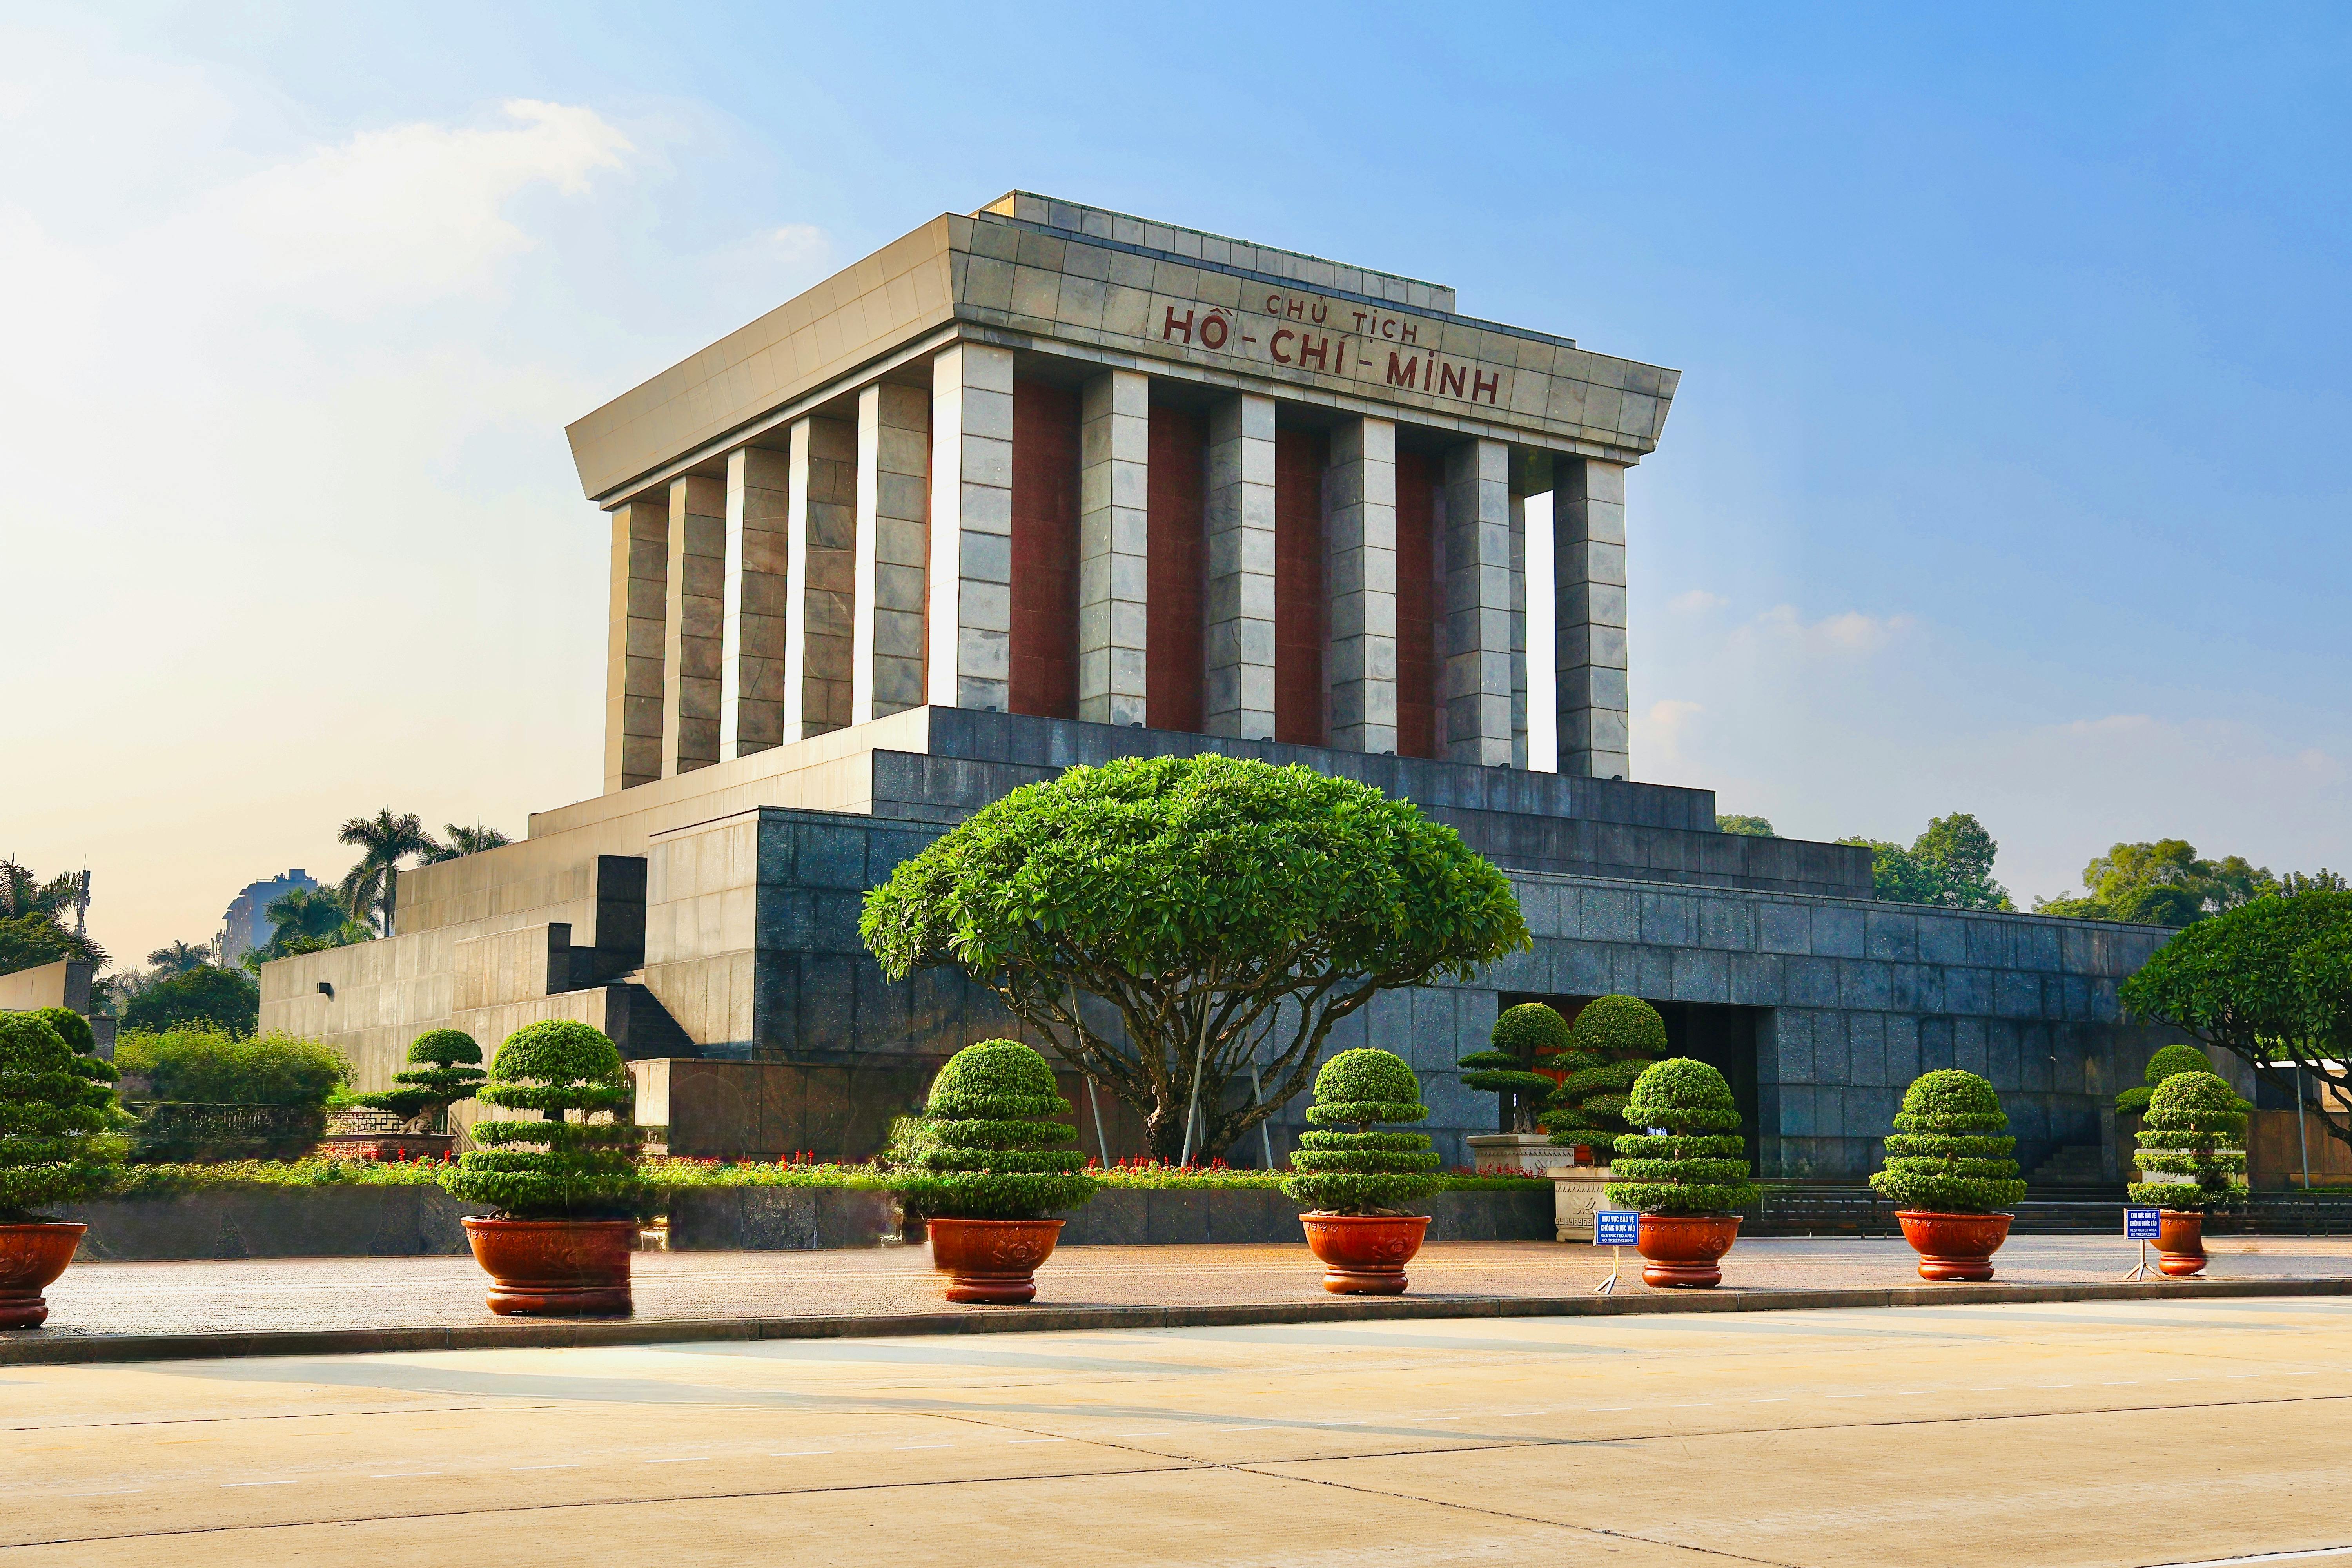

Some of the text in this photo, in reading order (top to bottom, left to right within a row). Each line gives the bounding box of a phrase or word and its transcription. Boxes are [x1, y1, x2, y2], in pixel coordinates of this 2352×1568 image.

[1267, 295, 1417, 343] CHỦ TỊCH
[1163, 306, 1233, 349] HỒ
[1270, 330, 1350, 374] CHÍ
[1386, 350, 1499, 405] MINH
[1615, 1224, 1626, 1233] ĐƯỢC
[1620, 1214, 1628, 1223] BẢO
[1629, 1215, 1634, 1224] VỆ
